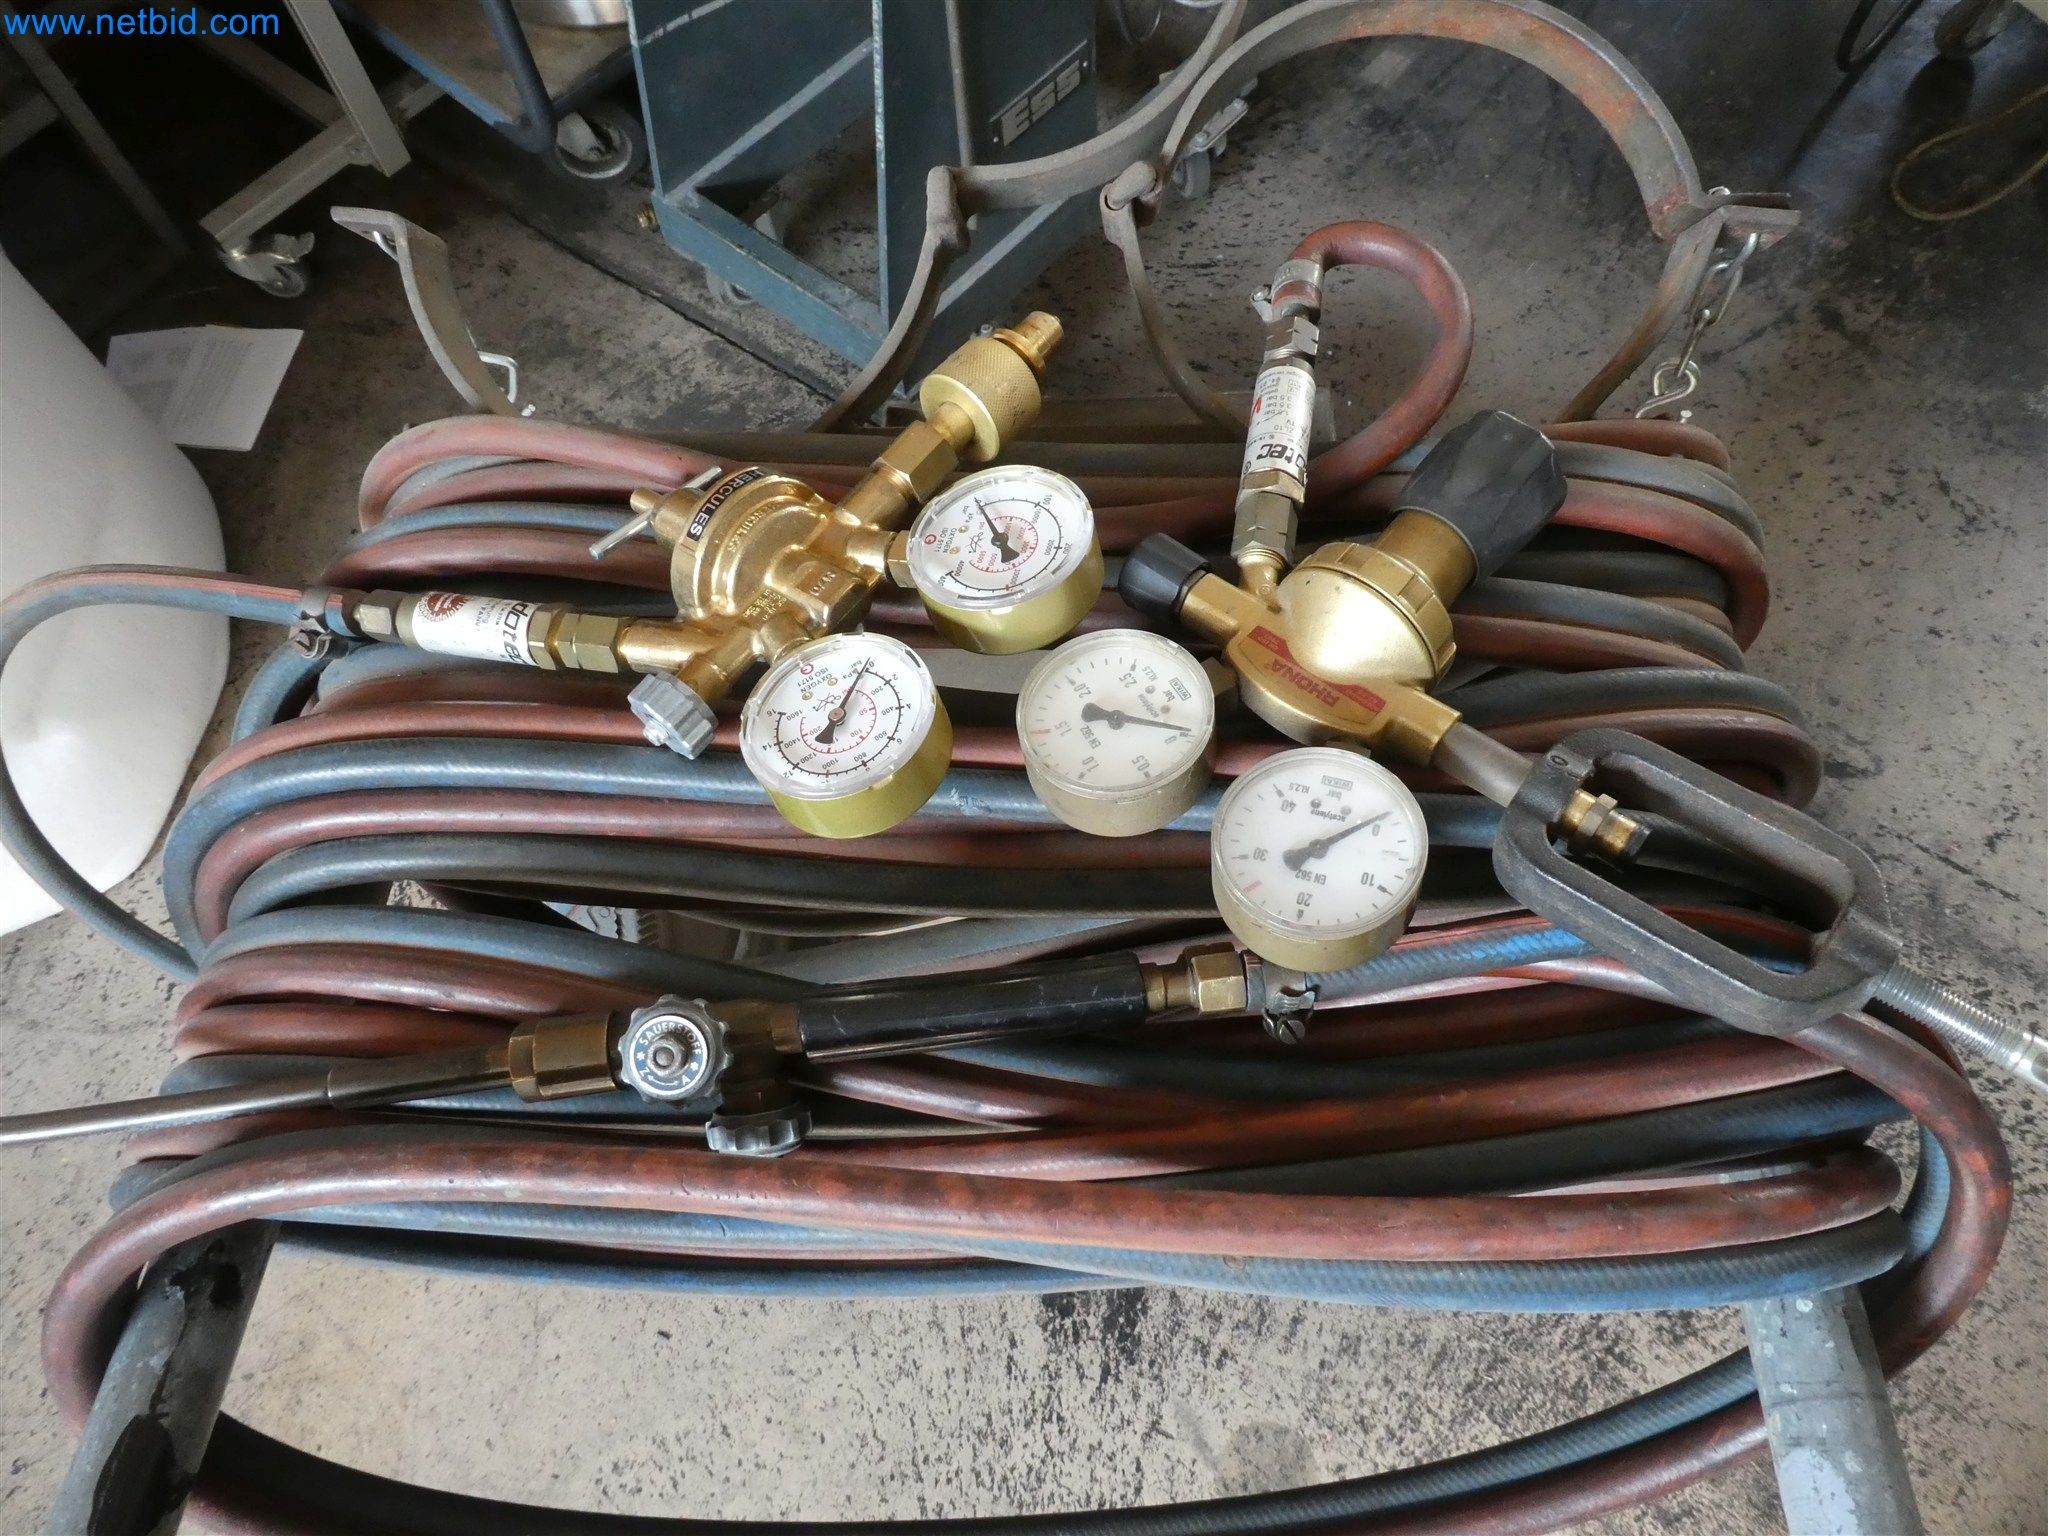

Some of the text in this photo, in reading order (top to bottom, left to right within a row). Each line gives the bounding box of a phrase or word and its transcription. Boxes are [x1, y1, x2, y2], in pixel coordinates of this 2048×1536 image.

[689, 468, 765, 537] HERCULES
[942, 527, 957, 554] OXYGEN
[850, 659, 863, 669] bar
[796, 666, 829, 687] ISO 5171
[1118, 672, 1138, 689] 2,5
[800, 673, 833, 694] OXYGEN
[1170, 678, 1191, 700] WIKA
[871, 685, 884, 696] 200
[1162, 688, 1177, 703] bar
[766, 708, 778, 717] 16
[786, 709, 803, 721] 1600
[859, 707, 870, 716] 50
[881, 706, 895, 716] 400
[809, 725, 823, 736] 200
[850, 728, 863, 738] 100
[874, 730, 888, 741] 600
[1079, 724, 1102, 750] EN 562
[784, 737, 801, 750] 1400
[1164, 735, 1177, 745] 0
[762, 742, 773, 752] 14
[800, 752, 818, 764] 1200
[853, 752, 868, 762] 800
[1131, 754, 1151, 772] 0,5
[822, 758, 840, 770] 1000
[783, 770, 794, 780] 12
[1326, 788, 1343, 801] bar
[1280, 799, 1297, 814] 40
[1371, 823, 1381, 837] 0
[1252, 847, 1269, 861] 30
[1295, 869, 1327, 886] EN 562
[1360, 871, 1375, 887] 10
[1296, 891, 1314, 907] 20
[639, 1021, 702, 1055] SAUERSTOFF
[640, 1066, 691, 1086] Z A
